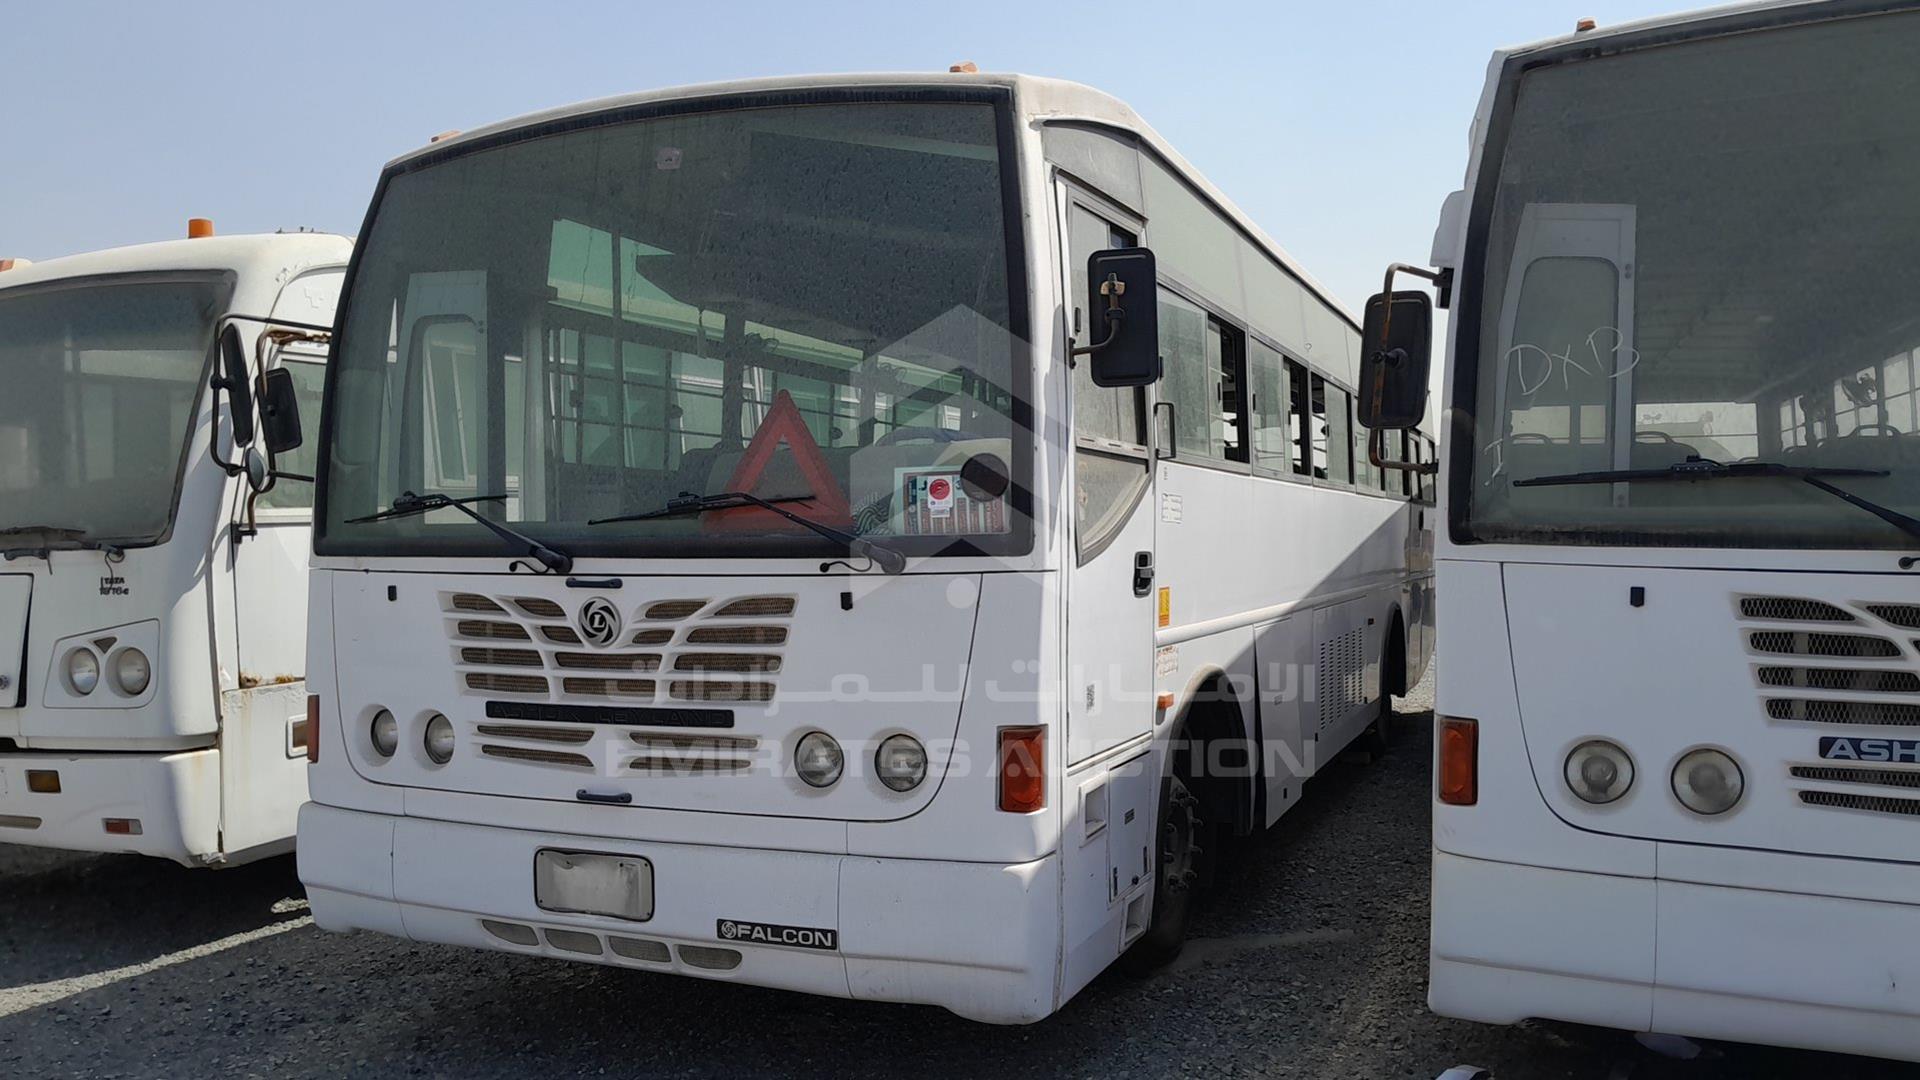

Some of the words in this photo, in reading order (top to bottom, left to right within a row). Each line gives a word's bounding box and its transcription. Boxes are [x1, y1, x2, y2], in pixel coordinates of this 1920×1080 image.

[1504, 326, 1640, 395] DXB
[1825, 738, 1920, 763] ASH
[737, 924, 832, 947] FALCON
